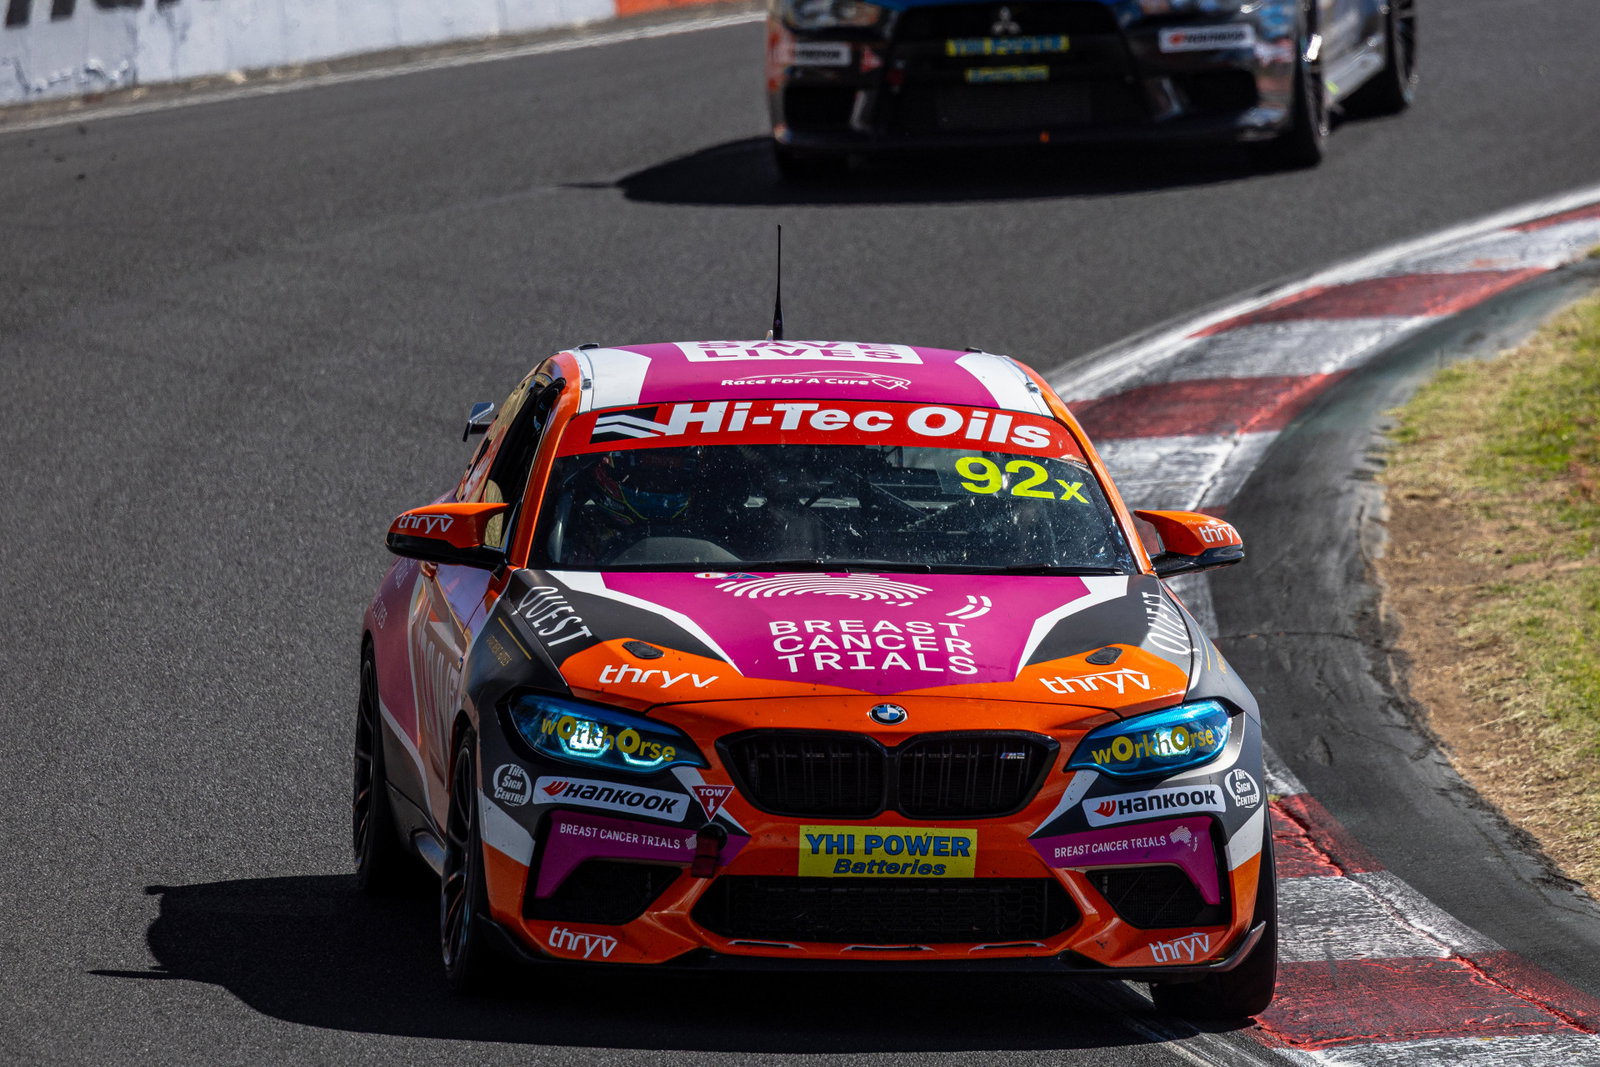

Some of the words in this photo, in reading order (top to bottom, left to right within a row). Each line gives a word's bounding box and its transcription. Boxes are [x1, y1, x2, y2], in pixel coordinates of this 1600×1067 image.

[704, 349, 903, 359] LIVES
[825, 378, 869, 386] Cure
[665, 401, 894, 436] Hi-Tec
[907, 406, 1051, 449] Oils
[398, 514, 454, 535] thryv
[511, 586, 593, 647] QUEST
[769, 620, 966, 637] BREAST
[1141, 592, 1200, 655] QUEST
[773, 634, 974, 655] CANCER
[777, 651, 978, 675] TRIALS
[599, 664, 719, 688] thryv
[1039, 669, 1150, 694] thryv
[699, 788, 726, 797] TOW
[559, 822, 598, 837] BREAST
[600, 828, 638, 843] CANCER
[641, 835, 681, 849] TRIALS
[805, 833, 855, 855] YHI
[864, 834, 971, 857] POWER
[1054, 844, 1089, 858] BREAST
[1092, 841, 1128, 854] CANCER
[1131, 835, 1167, 849] TRIALS
[833, 858, 947, 875] Batteries
[548, 926, 618, 958] thryv
[1149, 933, 1209, 962] thryv
